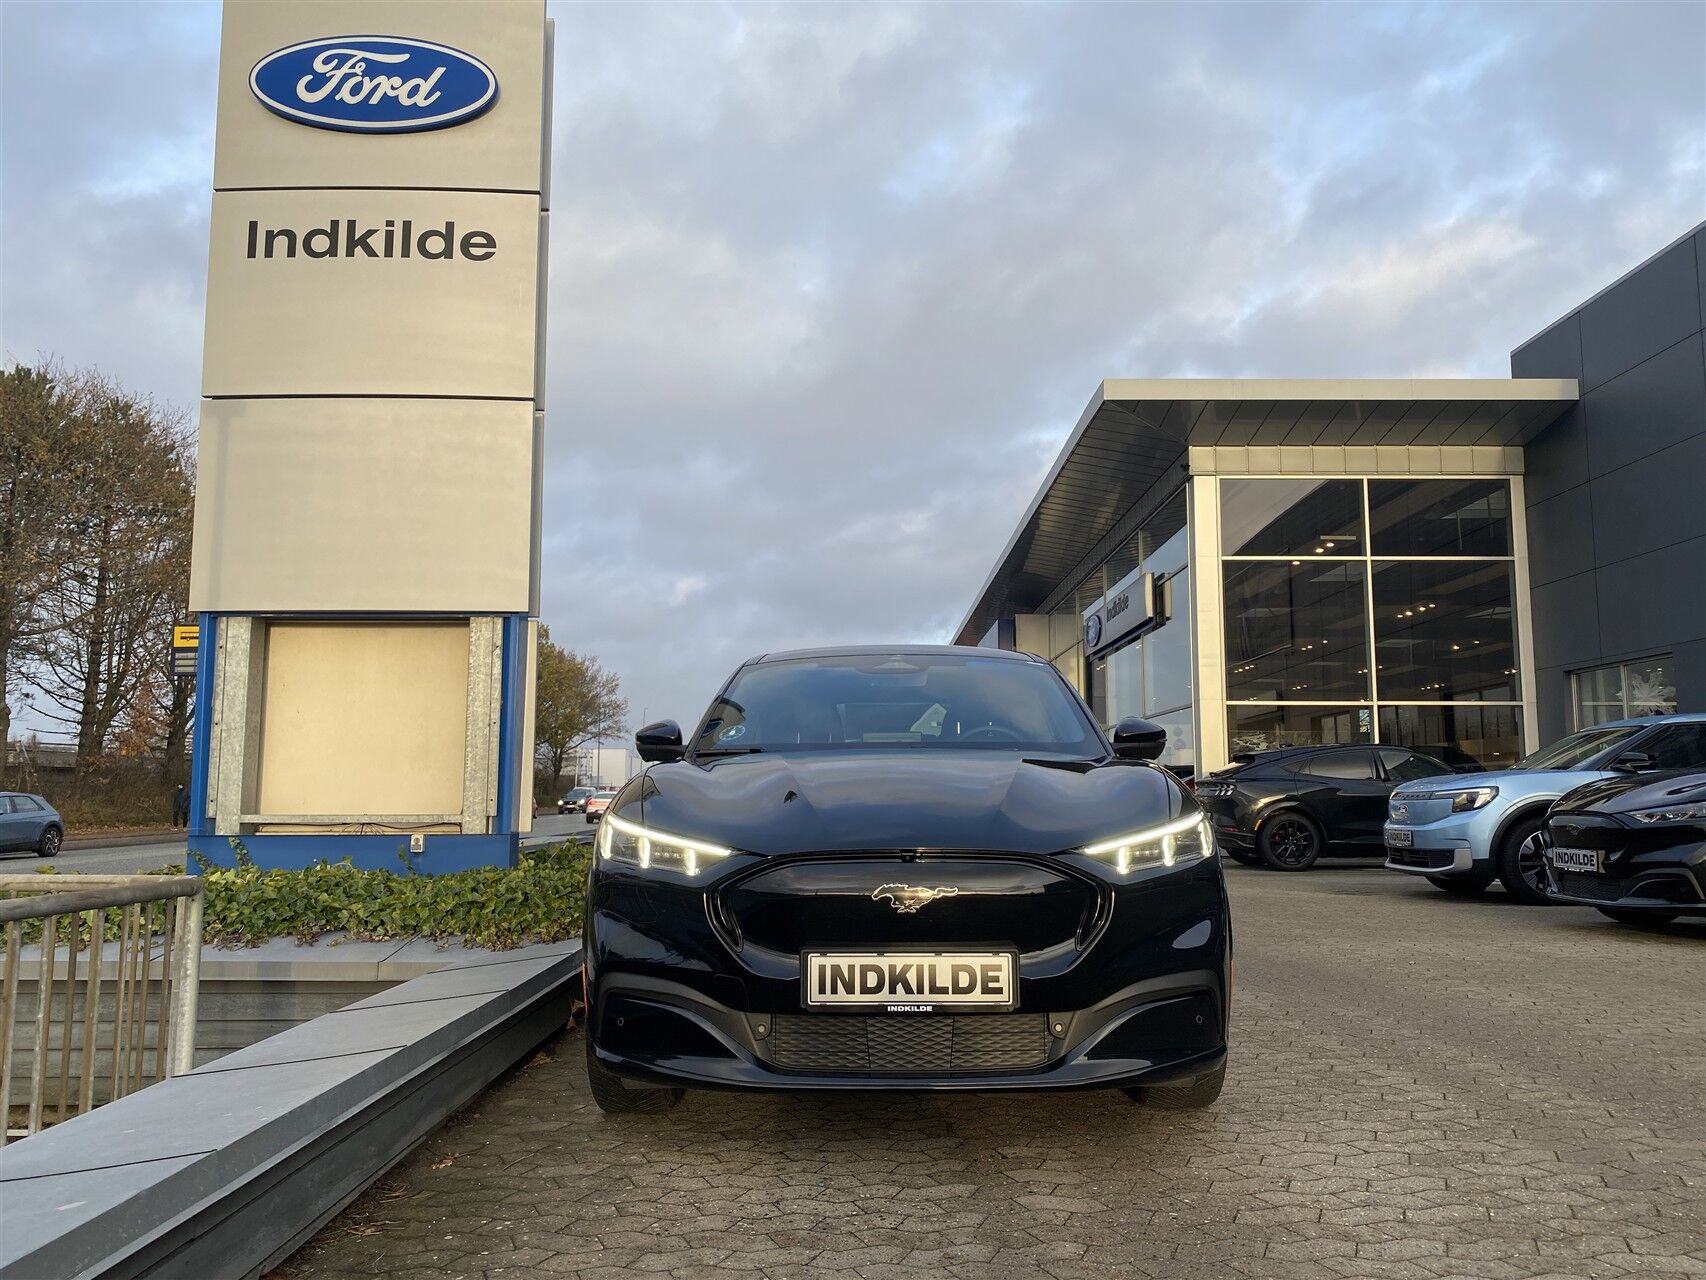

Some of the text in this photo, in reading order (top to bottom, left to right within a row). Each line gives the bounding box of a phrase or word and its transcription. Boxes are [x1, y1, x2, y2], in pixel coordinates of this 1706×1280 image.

[296, 48, 447, 108] Ford
[246, 219, 497, 262] Indkilde
[1106, 593, 1129, 623] Indkilde
[1555, 851, 1596, 867] INDKILDE
[817, 963, 1004, 995] INDKILDE
